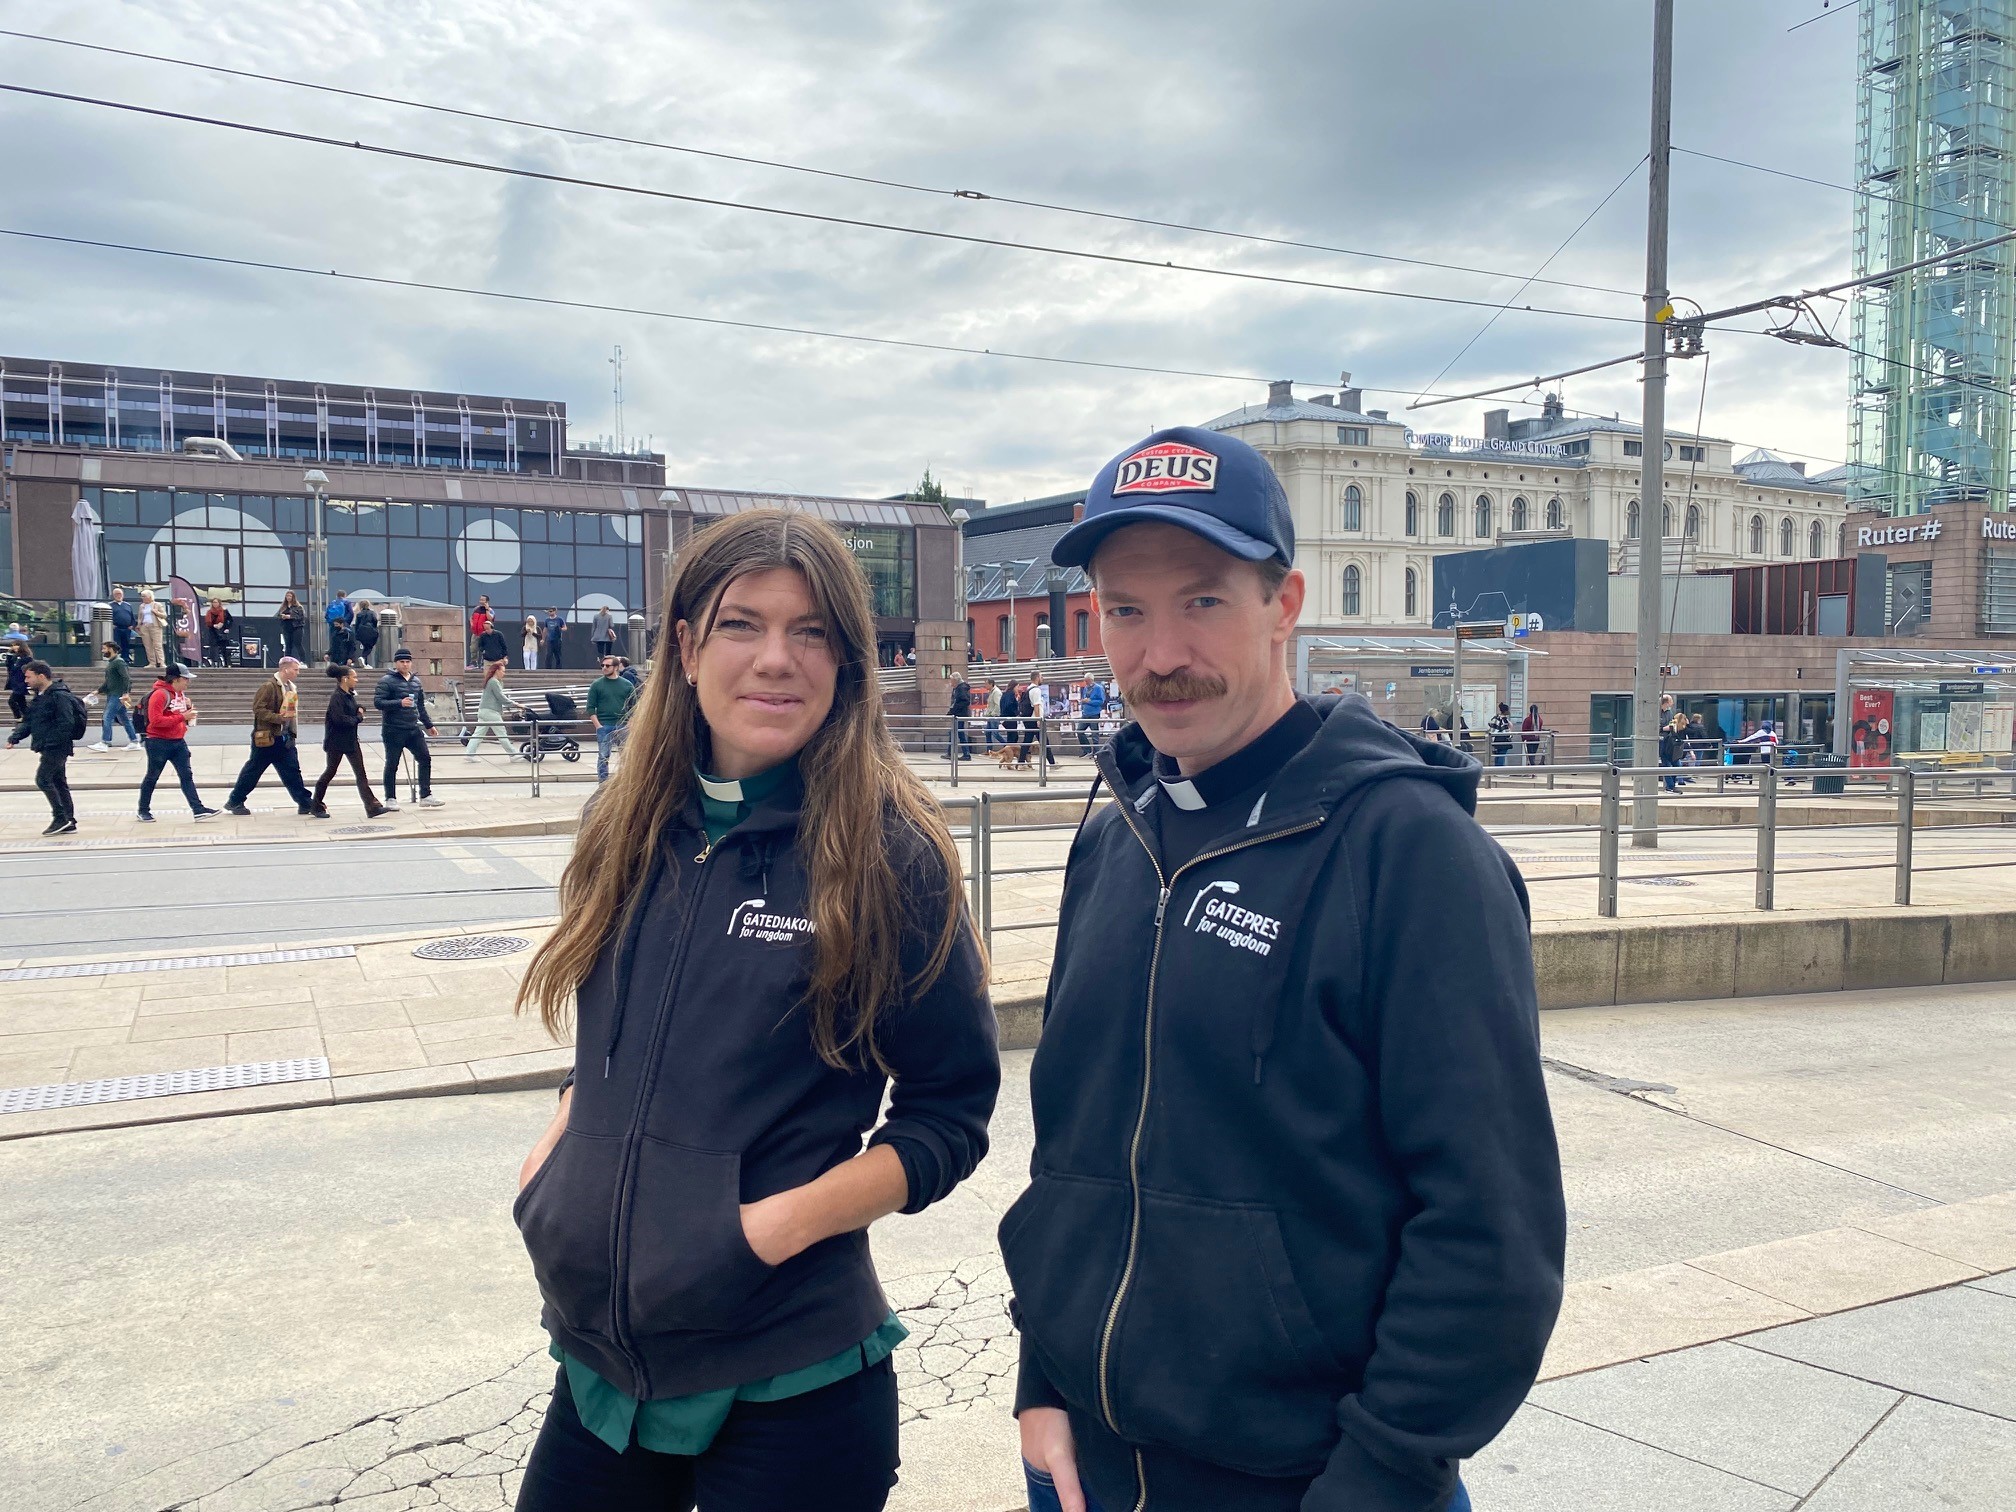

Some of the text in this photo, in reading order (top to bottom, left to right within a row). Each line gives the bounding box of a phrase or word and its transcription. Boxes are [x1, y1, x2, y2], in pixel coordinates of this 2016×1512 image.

[1141, 449, 1169, 457] CUSTOM
[1490, 438, 1525, 452] GRAND
[1121, 457, 1212, 486] DEUS
[1983, 517, 2016, 539] Rute
[841, 536, 873, 551] asjon
[743, 912, 817, 934] GATEDIAKON
[739, 926, 793, 942] for ungdom
[1195, 915, 1271, 956] for ungdom
